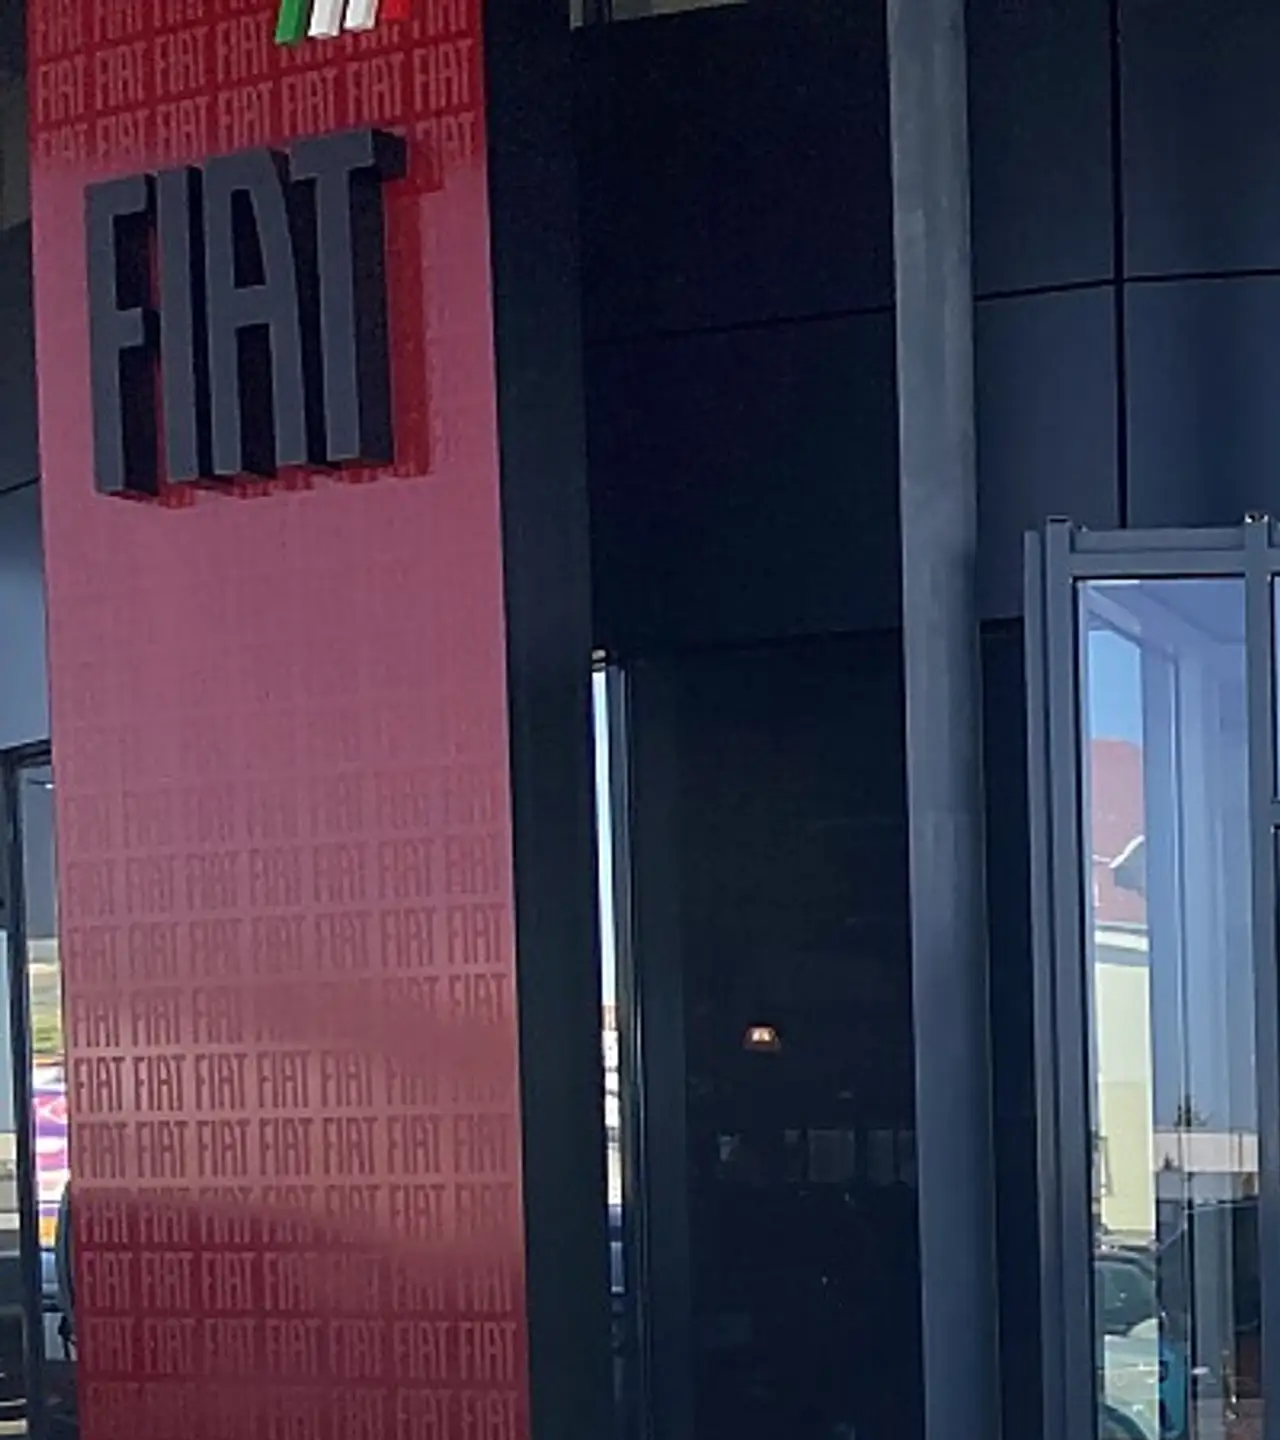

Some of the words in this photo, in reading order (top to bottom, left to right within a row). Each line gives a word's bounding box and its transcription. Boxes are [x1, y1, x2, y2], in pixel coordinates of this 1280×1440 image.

[155, 27, 209, 95] FIAT
[217, 12, 273, 81] FIAT
[219, 82, 275, 150] FIAT
[282, 68, 340, 137] FIAT
[347, 53, 406, 123] FIAT
[414, 38, 474, 109] FIAT
[85, 126, 388, 496] FIAT
[446, 904, 505, 964] FIAT
[74, 1057, 126, 1112] FIAT
[134, 1055, 187, 1111] FIAT
[195, 1053, 249, 1109] FIAT
[257, 1051, 312, 1108] FIAT
[321, 1049, 377, 1106] FIAT
[77, 1123, 129, 1177] FIAT
[136, 1121, 190, 1177] FIAT
[197, 1120, 252, 1176] FIAT
[260, 1119, 315, 1175] FIAT
[323, 1117, 379, 1174] FIAT
[388, 1116, 445, 1173] FIAT
[202, 1254, 256, 1309] FIAT
[460, 1322, 518, 1380] FIAT
